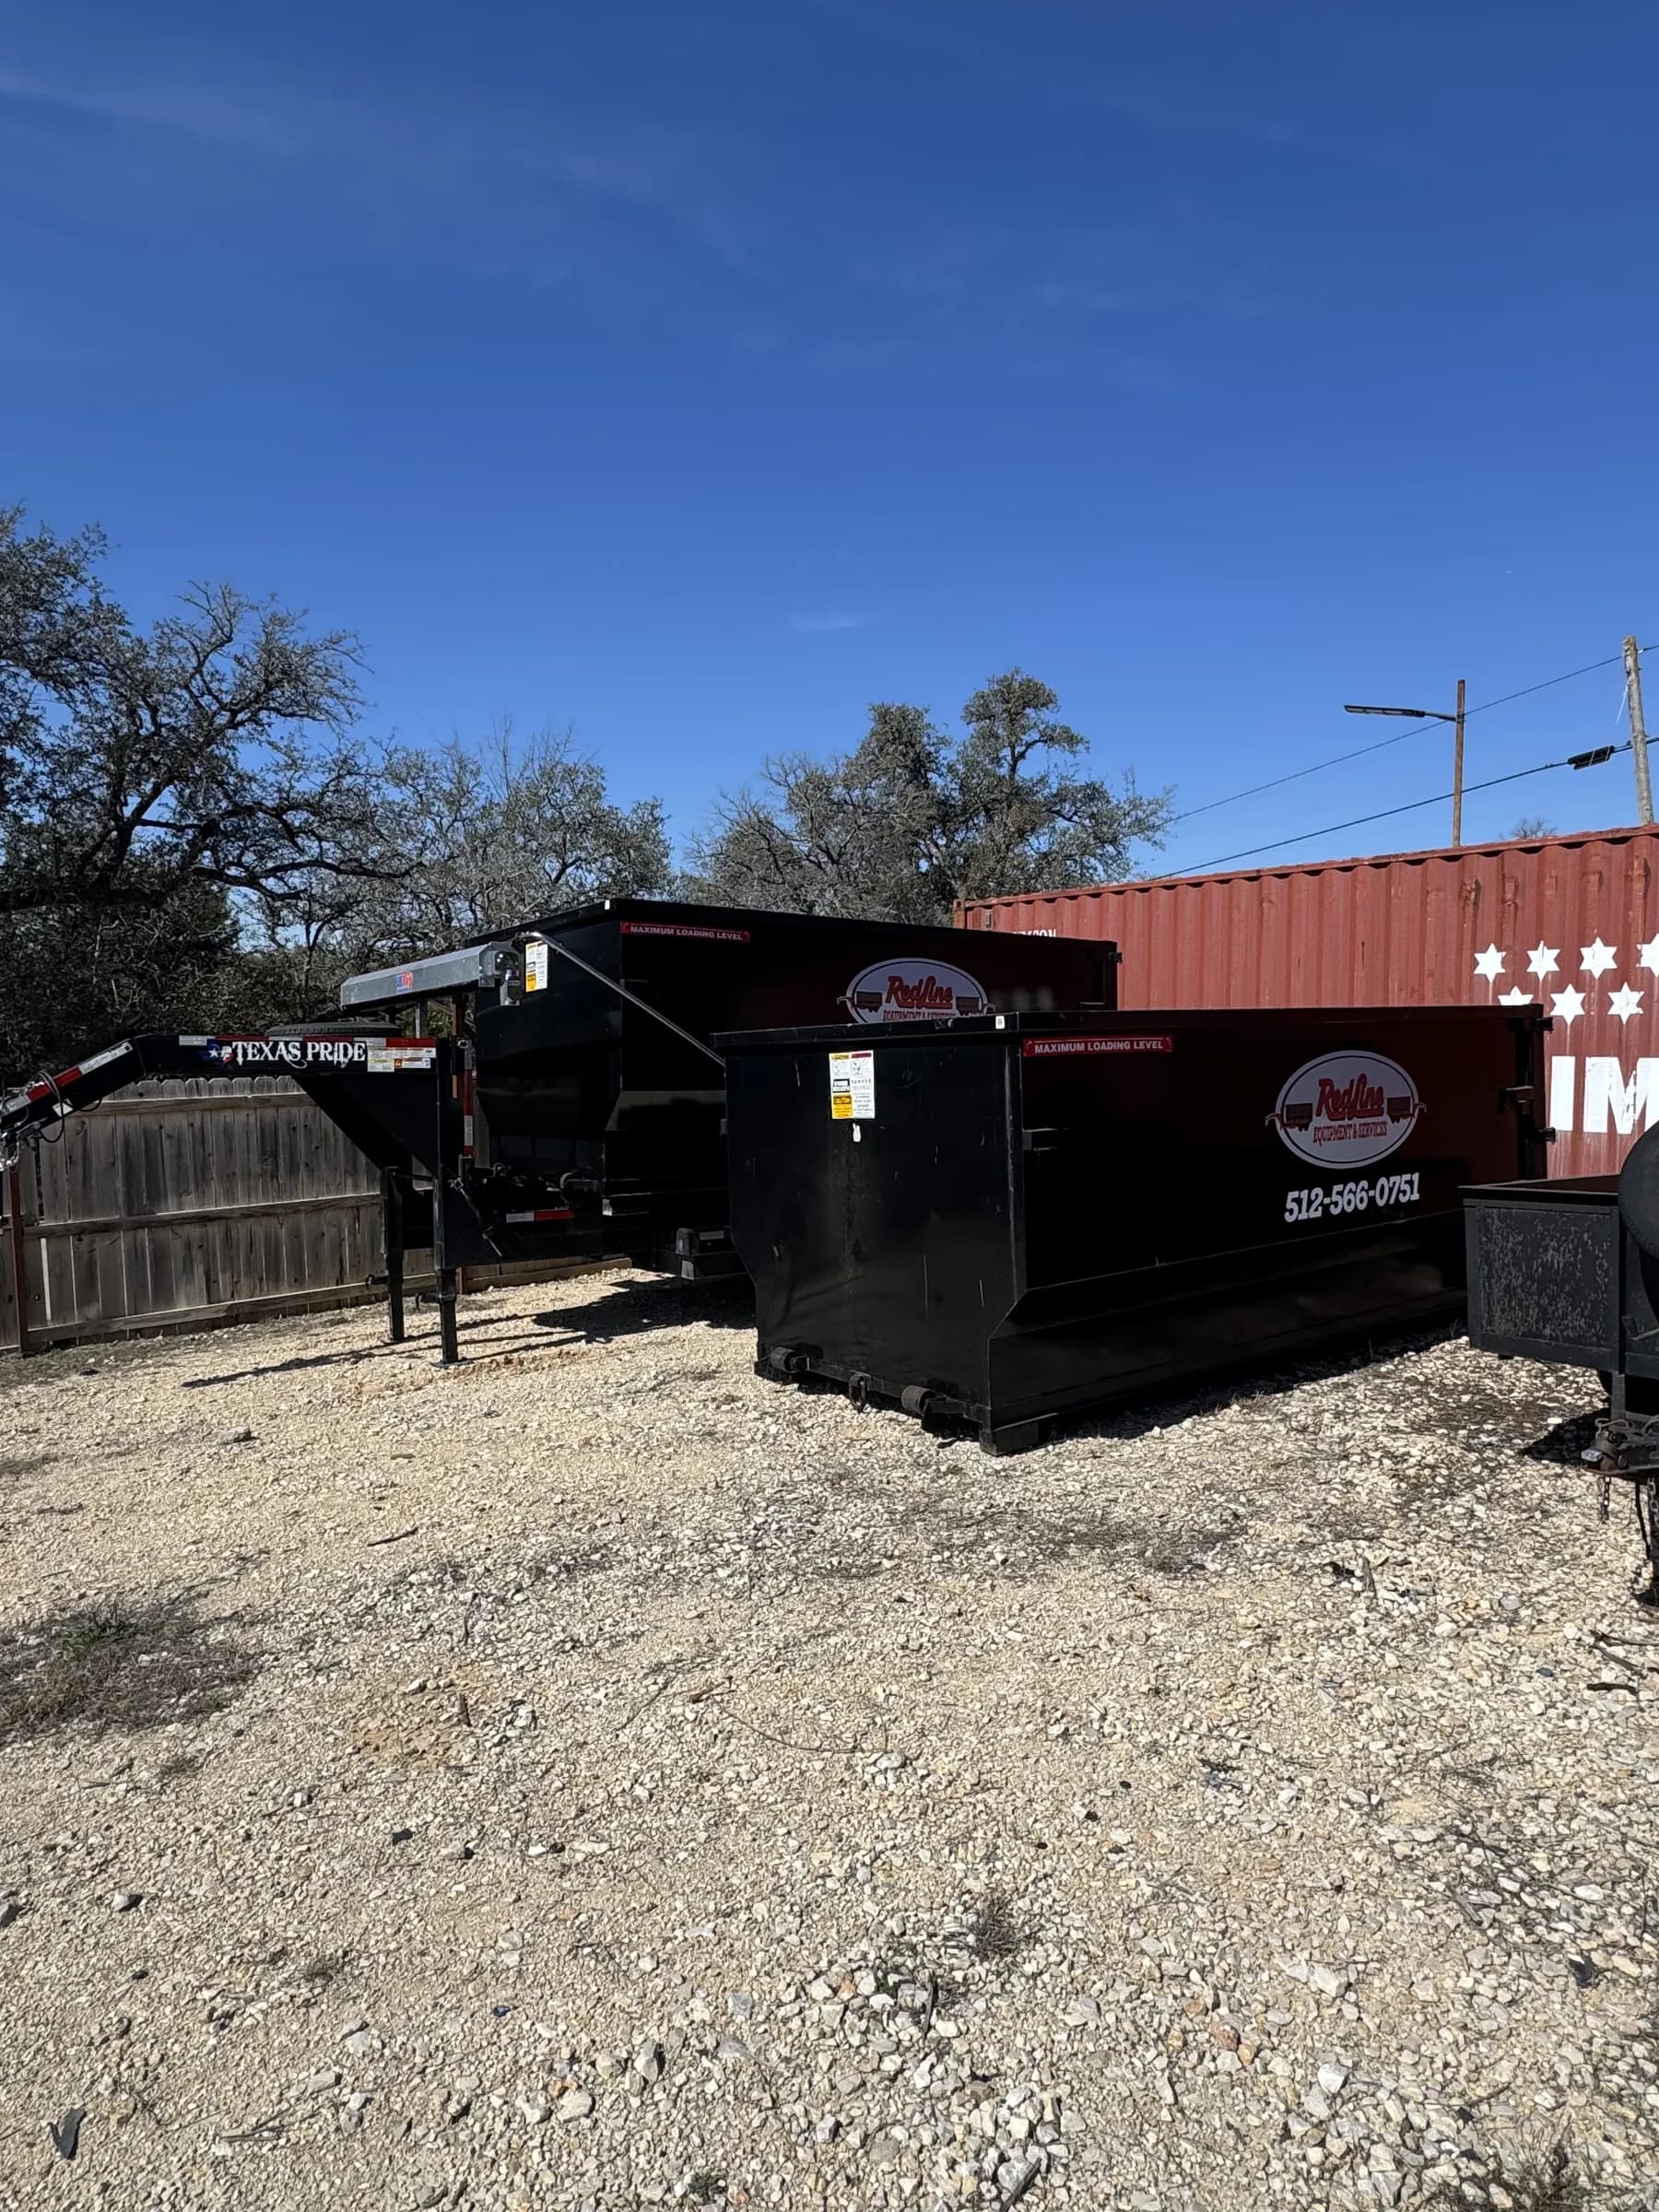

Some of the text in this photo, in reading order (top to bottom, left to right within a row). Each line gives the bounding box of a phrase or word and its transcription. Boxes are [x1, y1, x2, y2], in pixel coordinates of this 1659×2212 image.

[630, 924, 743, 940] MAXIMUM LOADING LEVEL
[232, 1041, 307, 1068] TEXAS
[307, 1041, 365, 1068] PRIDE
[1034, 1041, 1163, 1053] MAXIMUM LOADING LEVEL
[1313, 1124, 1352, 1147] EQUIPMENT
[1359, 1121, 1388, 1138] SERVICES
[1284, 1172, 1419, 1222] 512-566-0751
